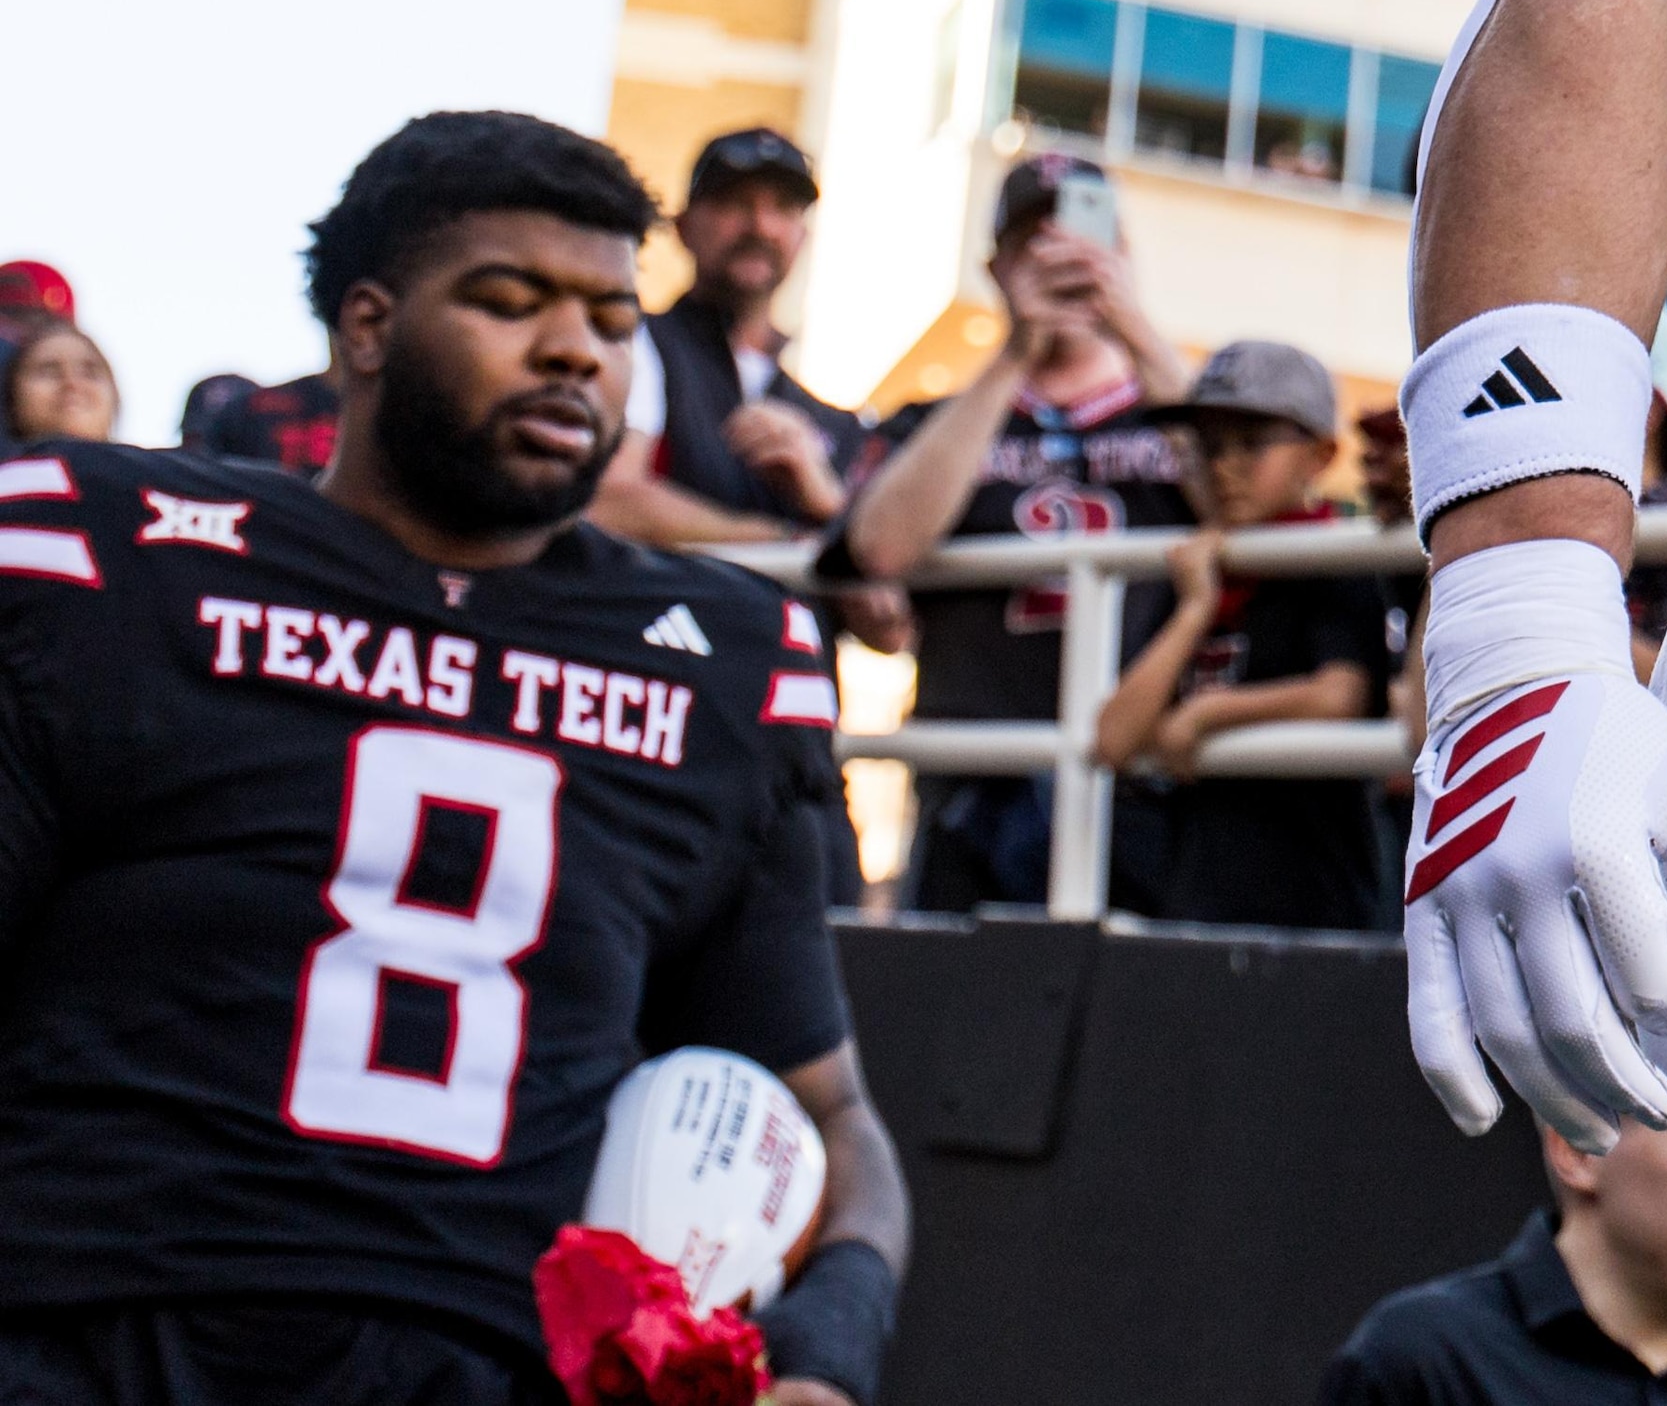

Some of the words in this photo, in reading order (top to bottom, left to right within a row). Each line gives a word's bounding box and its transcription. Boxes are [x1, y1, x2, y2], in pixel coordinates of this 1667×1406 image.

[199, 596, 479, 718] TEXAS
[501, 648, 694, 767] TECH
[281, 721, 567, 1171] 8
